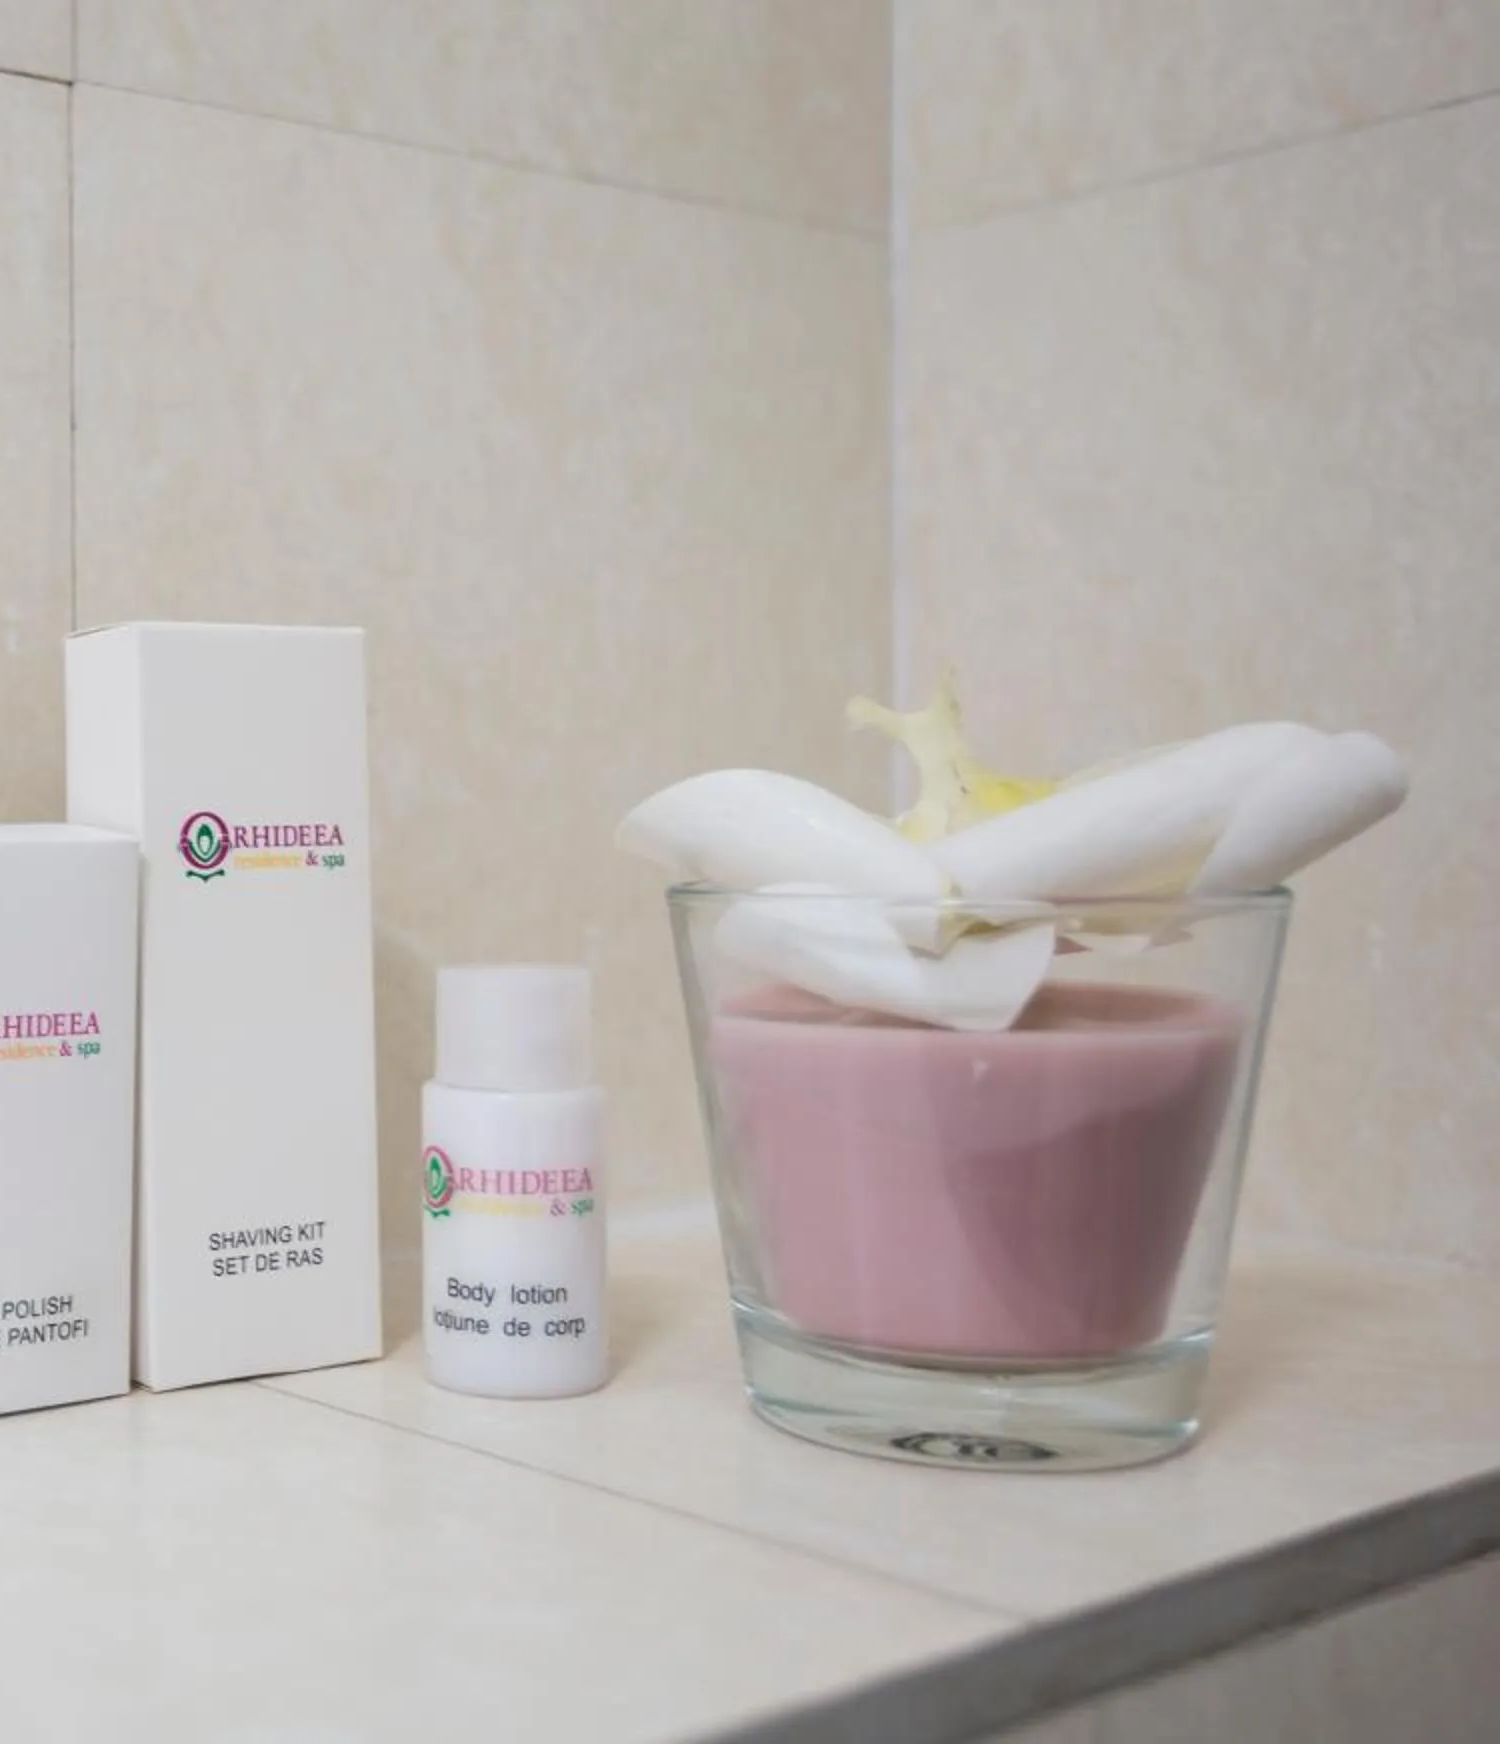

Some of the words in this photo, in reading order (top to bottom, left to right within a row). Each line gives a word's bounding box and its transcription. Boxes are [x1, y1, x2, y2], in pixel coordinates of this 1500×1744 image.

[179, 811, 344, 870] ORHIDEEA
[305, 851, 319, 867] &
[321, 855, 346, 869] spa
[59, 1040, 73, 1057] &
[77, 1043, 100, 1059] spa
[209, 1225, 293, 1251] SHAVING
[297, 1221, 325, 1241] KIT
[212, 1255, 250, 1277] SET
[255, 1251, 280, 1272] DE
[286, 1247, 324, 1268] RAS
[447, 1277, 496, 1307] Body
[511, 1284, 568, 1305] lotion
[2, 1295, 73, 1320] POLISH
[7, 1319, 88, 1346] PANTOFI
[503, 1317, 531, 1337] de
[544, 1317, 586, 1338] corp
